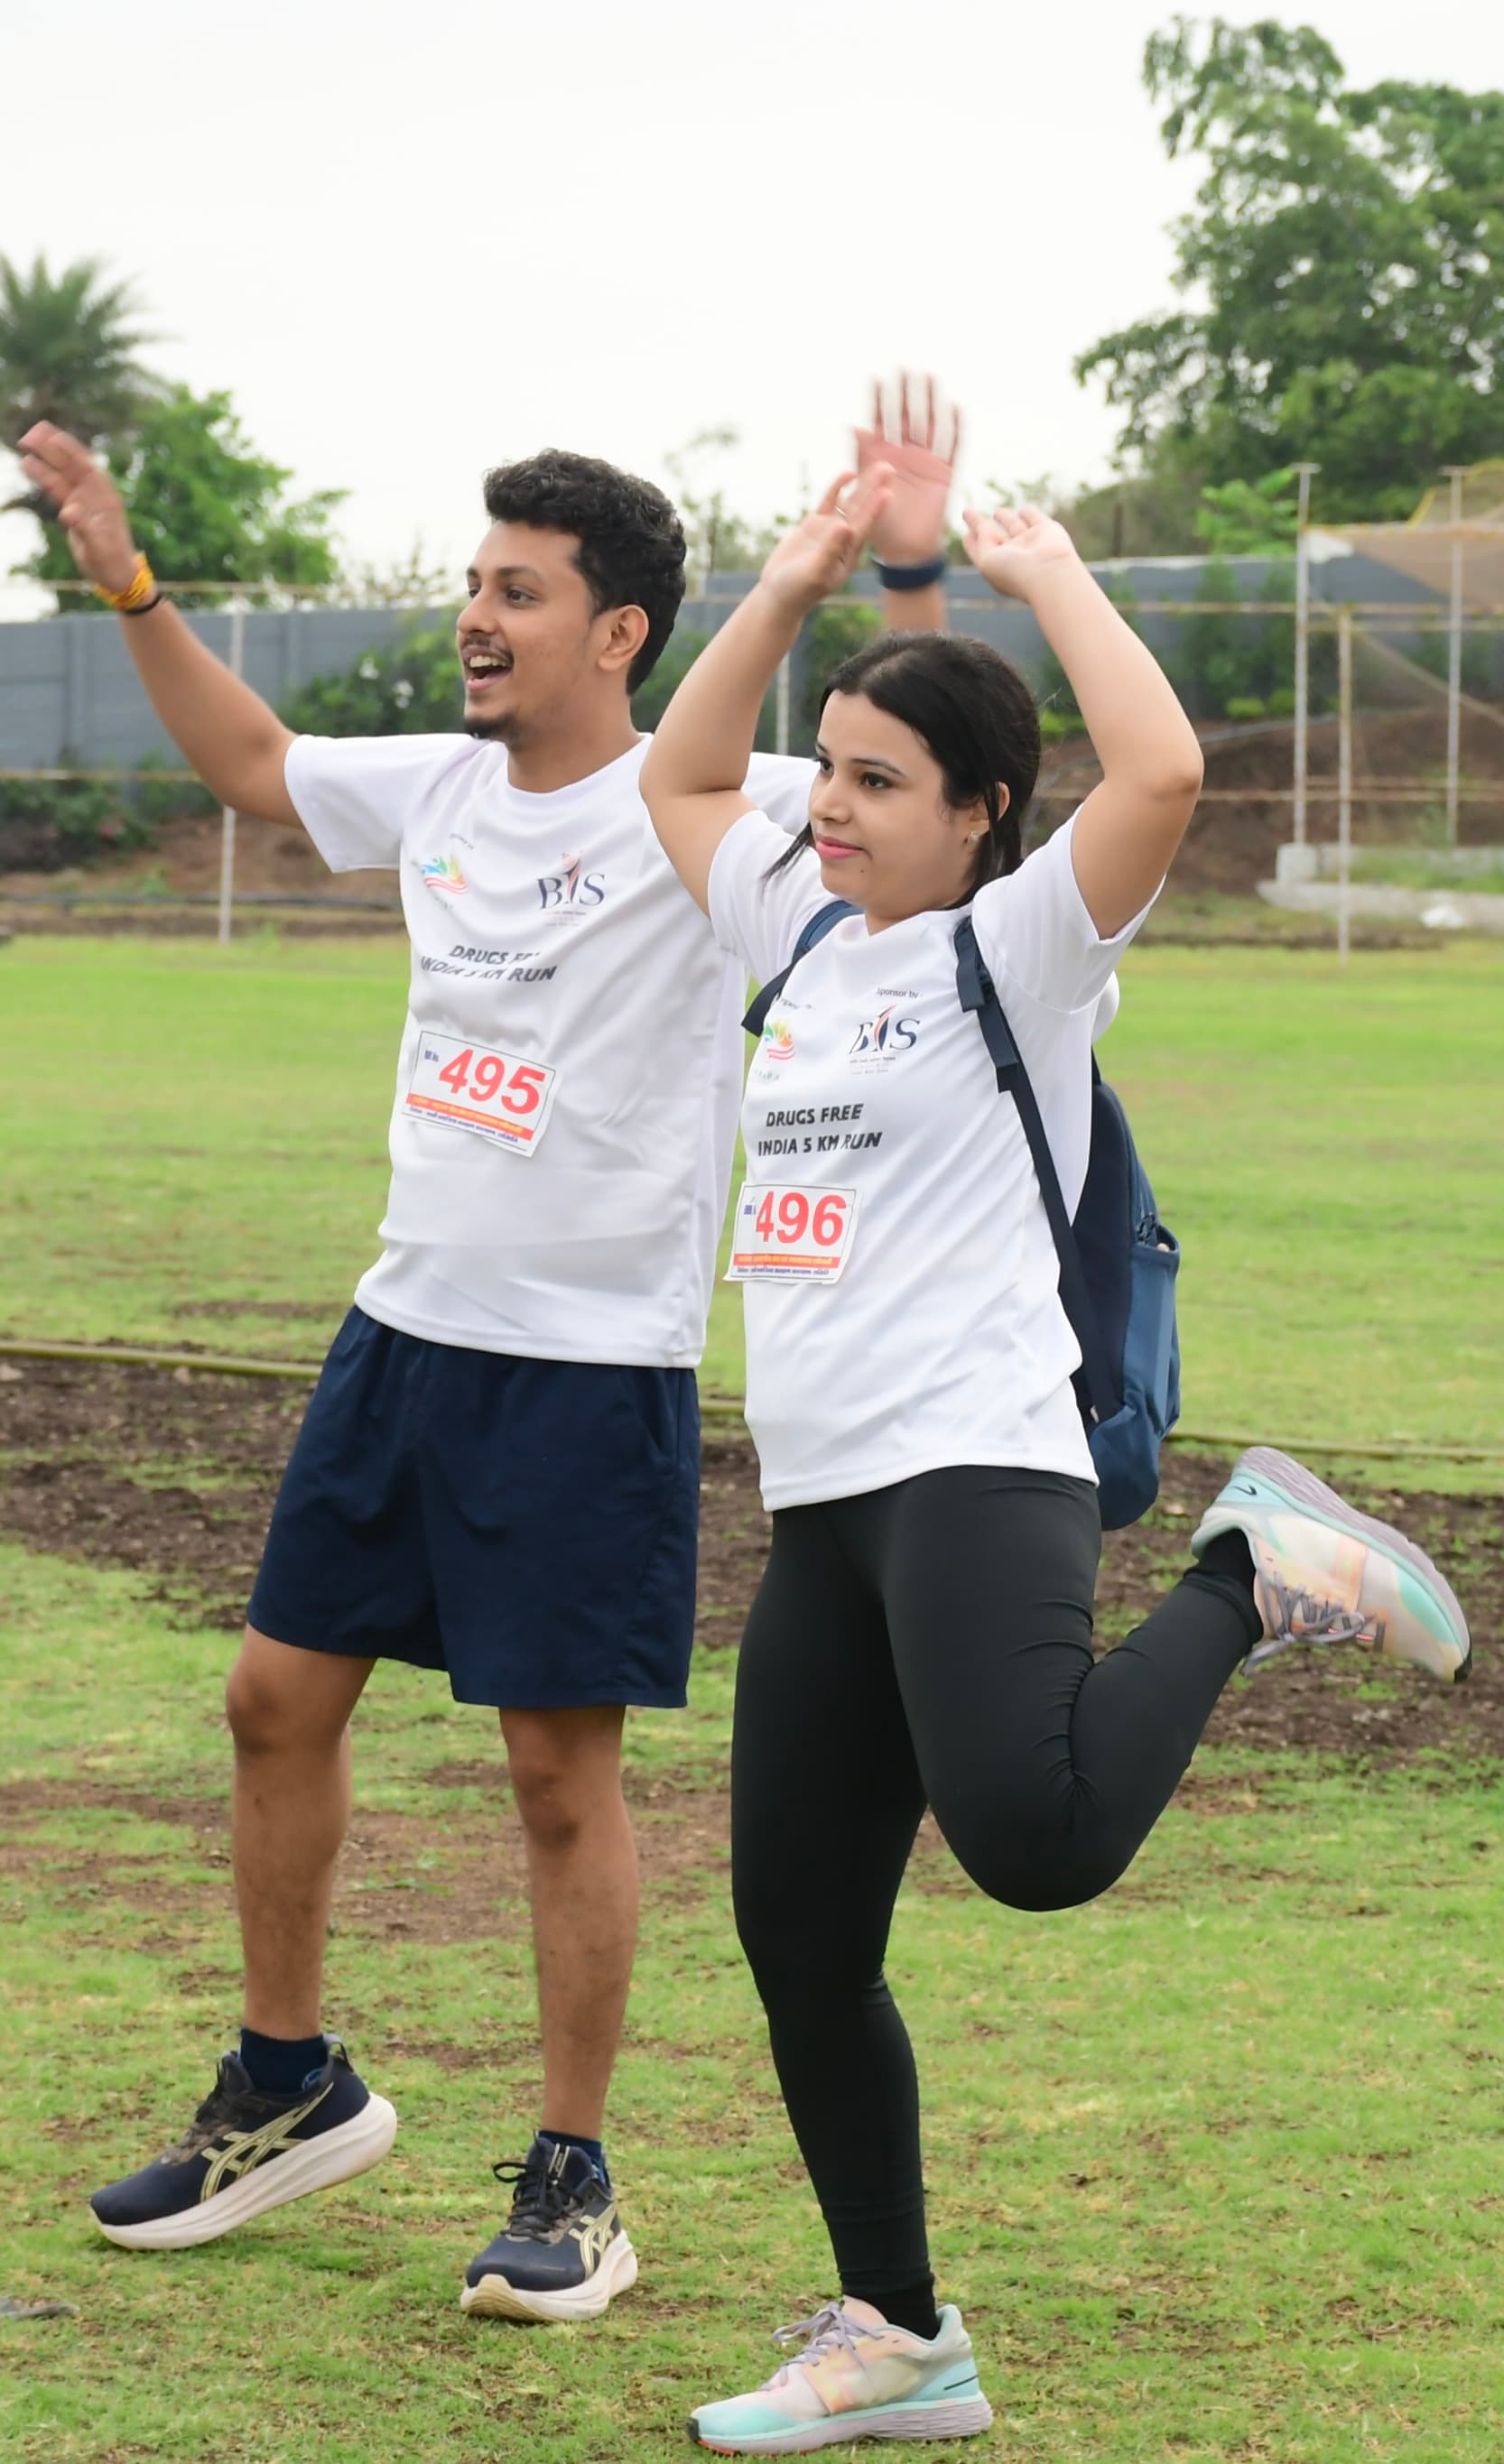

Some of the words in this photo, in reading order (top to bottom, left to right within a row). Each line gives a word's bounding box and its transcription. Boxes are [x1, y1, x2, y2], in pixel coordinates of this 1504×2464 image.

[506, 965, 558, 982] RUN
[439, 1049, 546, 1114] 495
[766, 1108, 815, 1127] DRUGS
[821, 1103, 864, 1123] FREE
[758, 1138, 797, 1156] INDIA
[803, 1137, 812, 1153] 5
[817, 1135, 840, 1152] KM
[840, 1132, 883, 1150] RUN
[756, 1190, 847, 1246] 496
